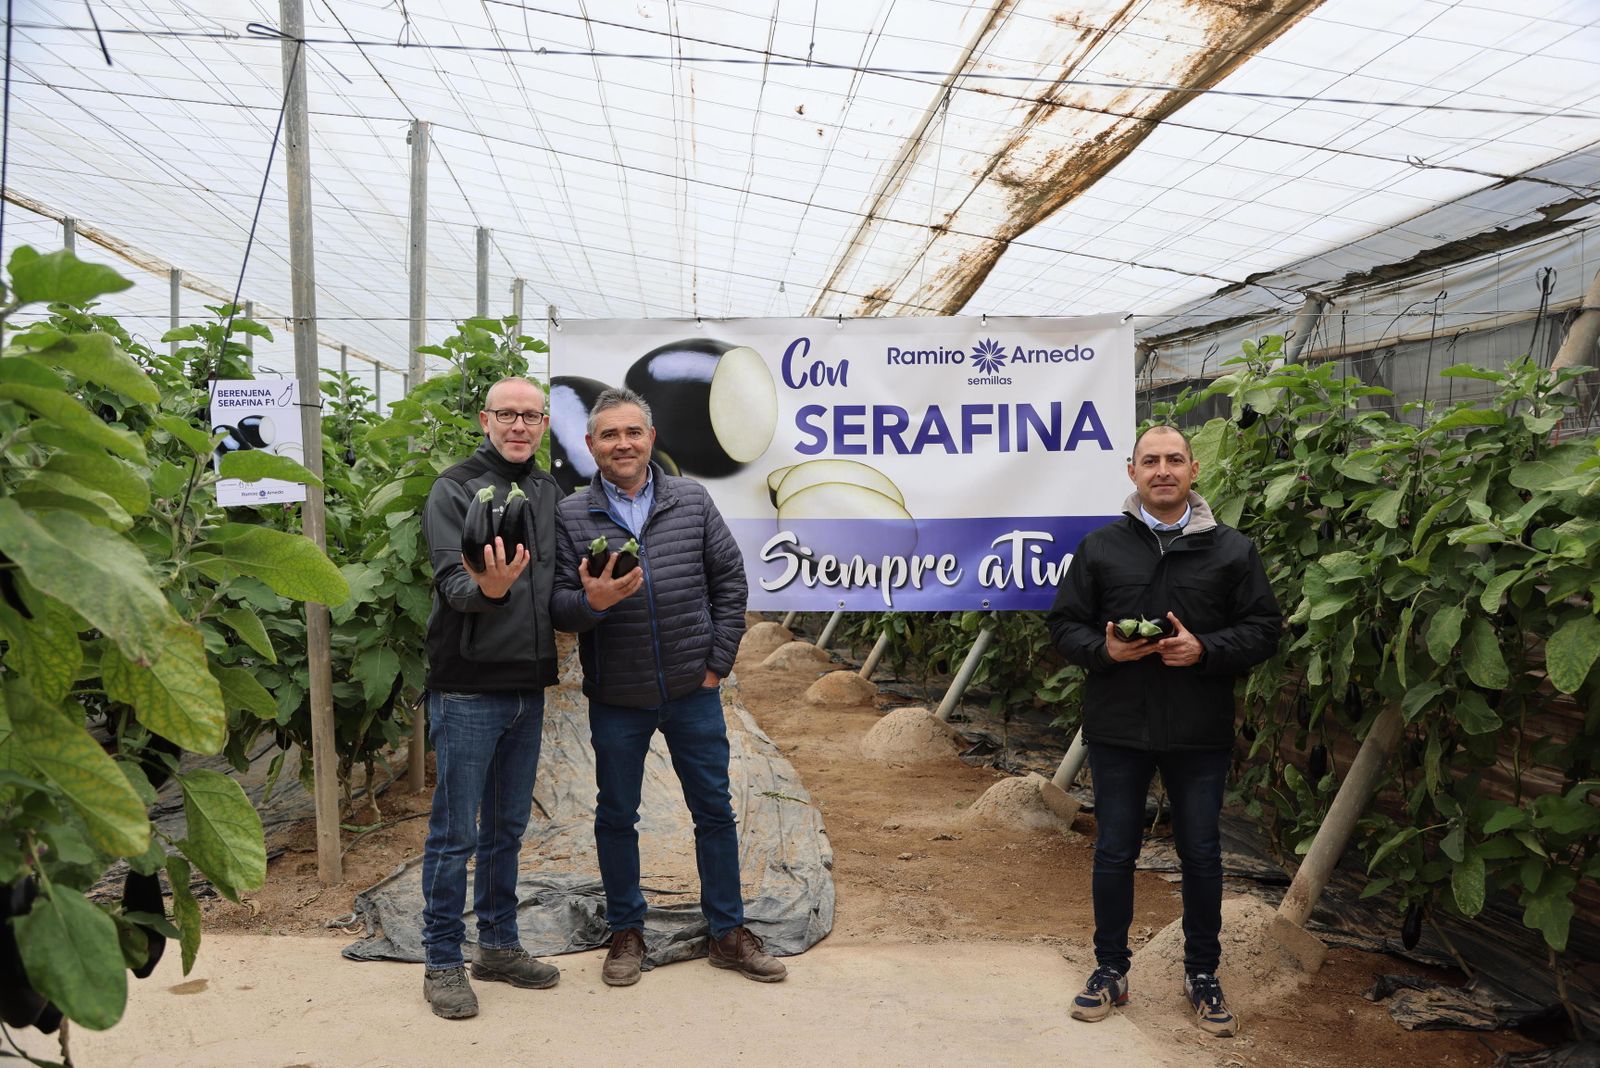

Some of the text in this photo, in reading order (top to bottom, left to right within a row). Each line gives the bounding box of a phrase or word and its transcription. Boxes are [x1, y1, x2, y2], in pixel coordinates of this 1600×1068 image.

[780, 337, 849, 389] Con
[887, 344, 1095, 365] Ramiro Arnedo
[967, 375, 1012, 386] semillas
[217, 389, 271, 397] BERENJENA
[217, 398, 275, 407] SERAFINA F1
[794, 400, 1113, 456] SERAFINA
[759, 530, 963, 607] Siempre
